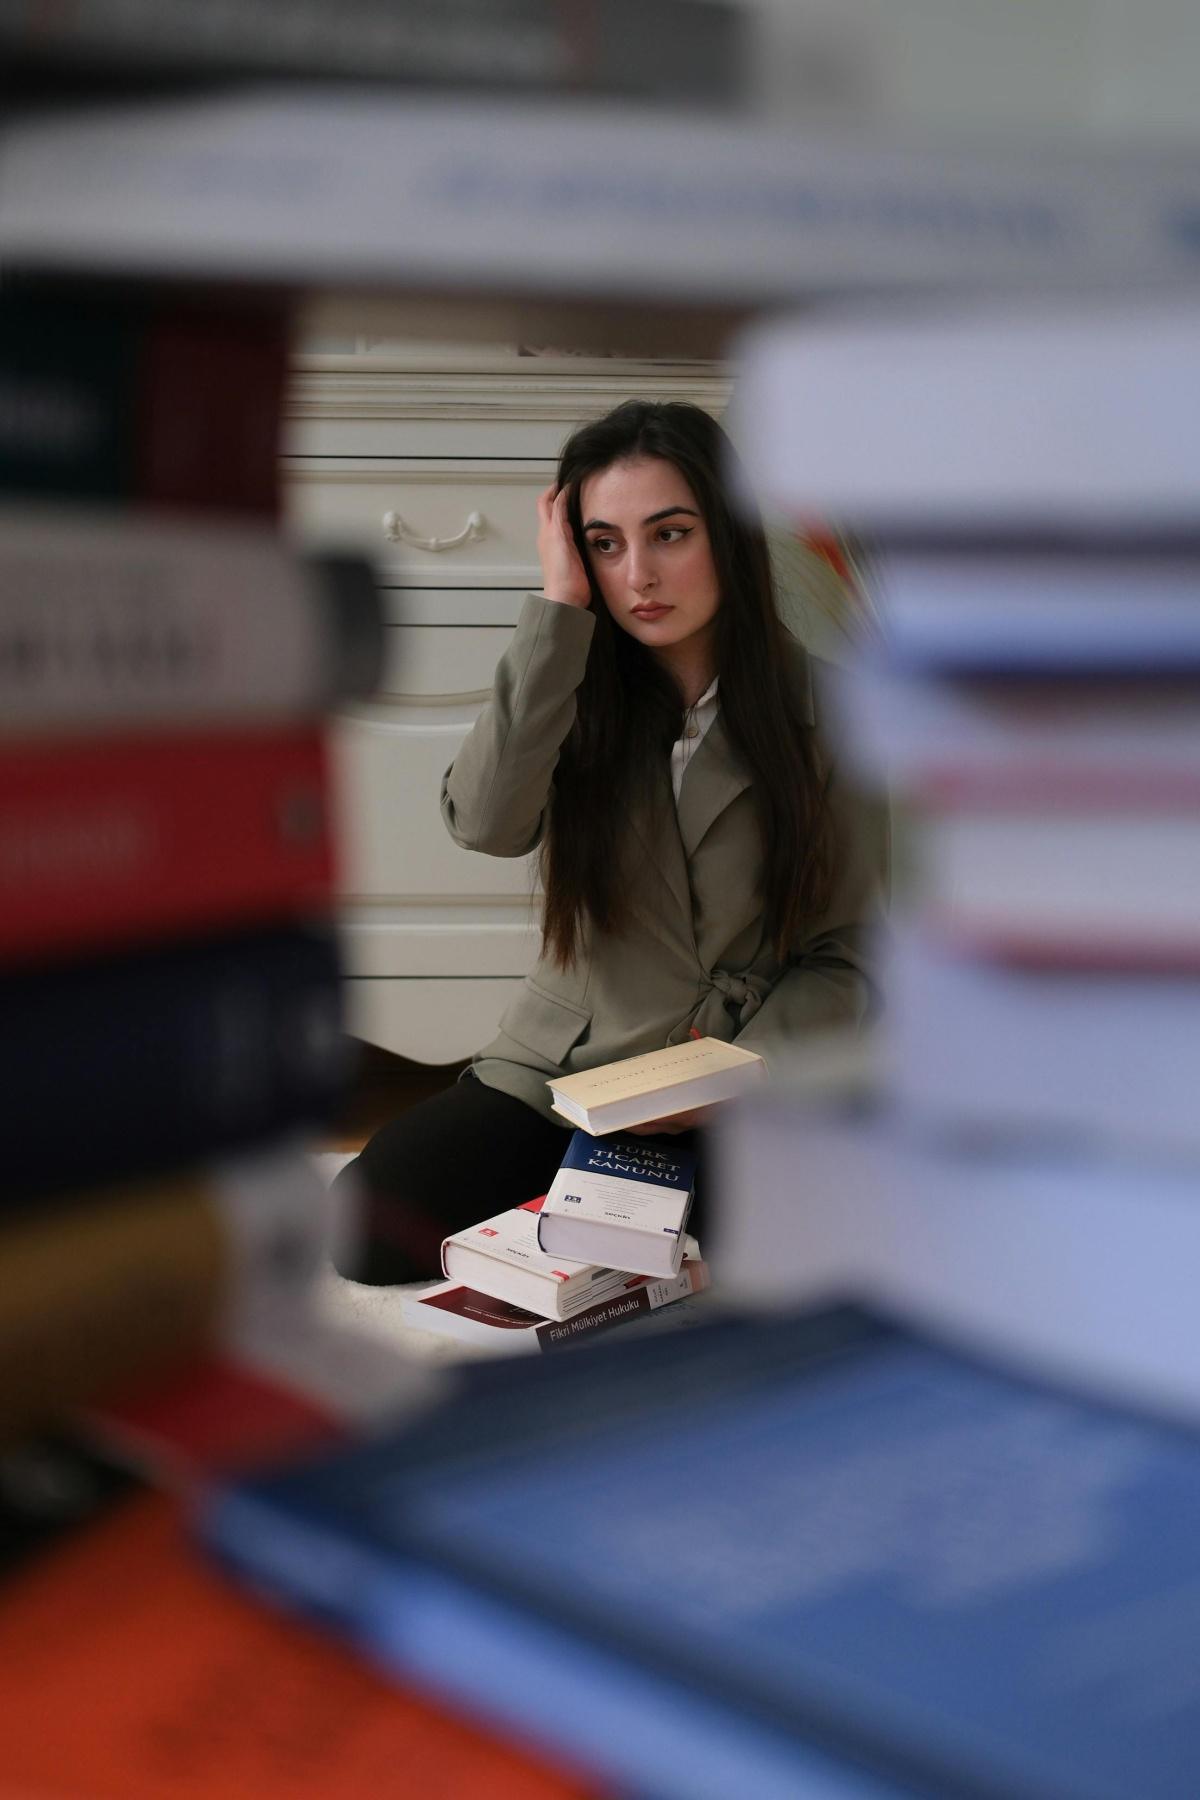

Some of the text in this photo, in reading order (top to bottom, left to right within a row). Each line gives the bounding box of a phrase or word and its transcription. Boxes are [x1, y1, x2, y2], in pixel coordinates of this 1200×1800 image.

[587, 1158, 679, 1182] KANUNU
[550, 1299, 640, 1341] Fikri Mülkiyet Hukuku
